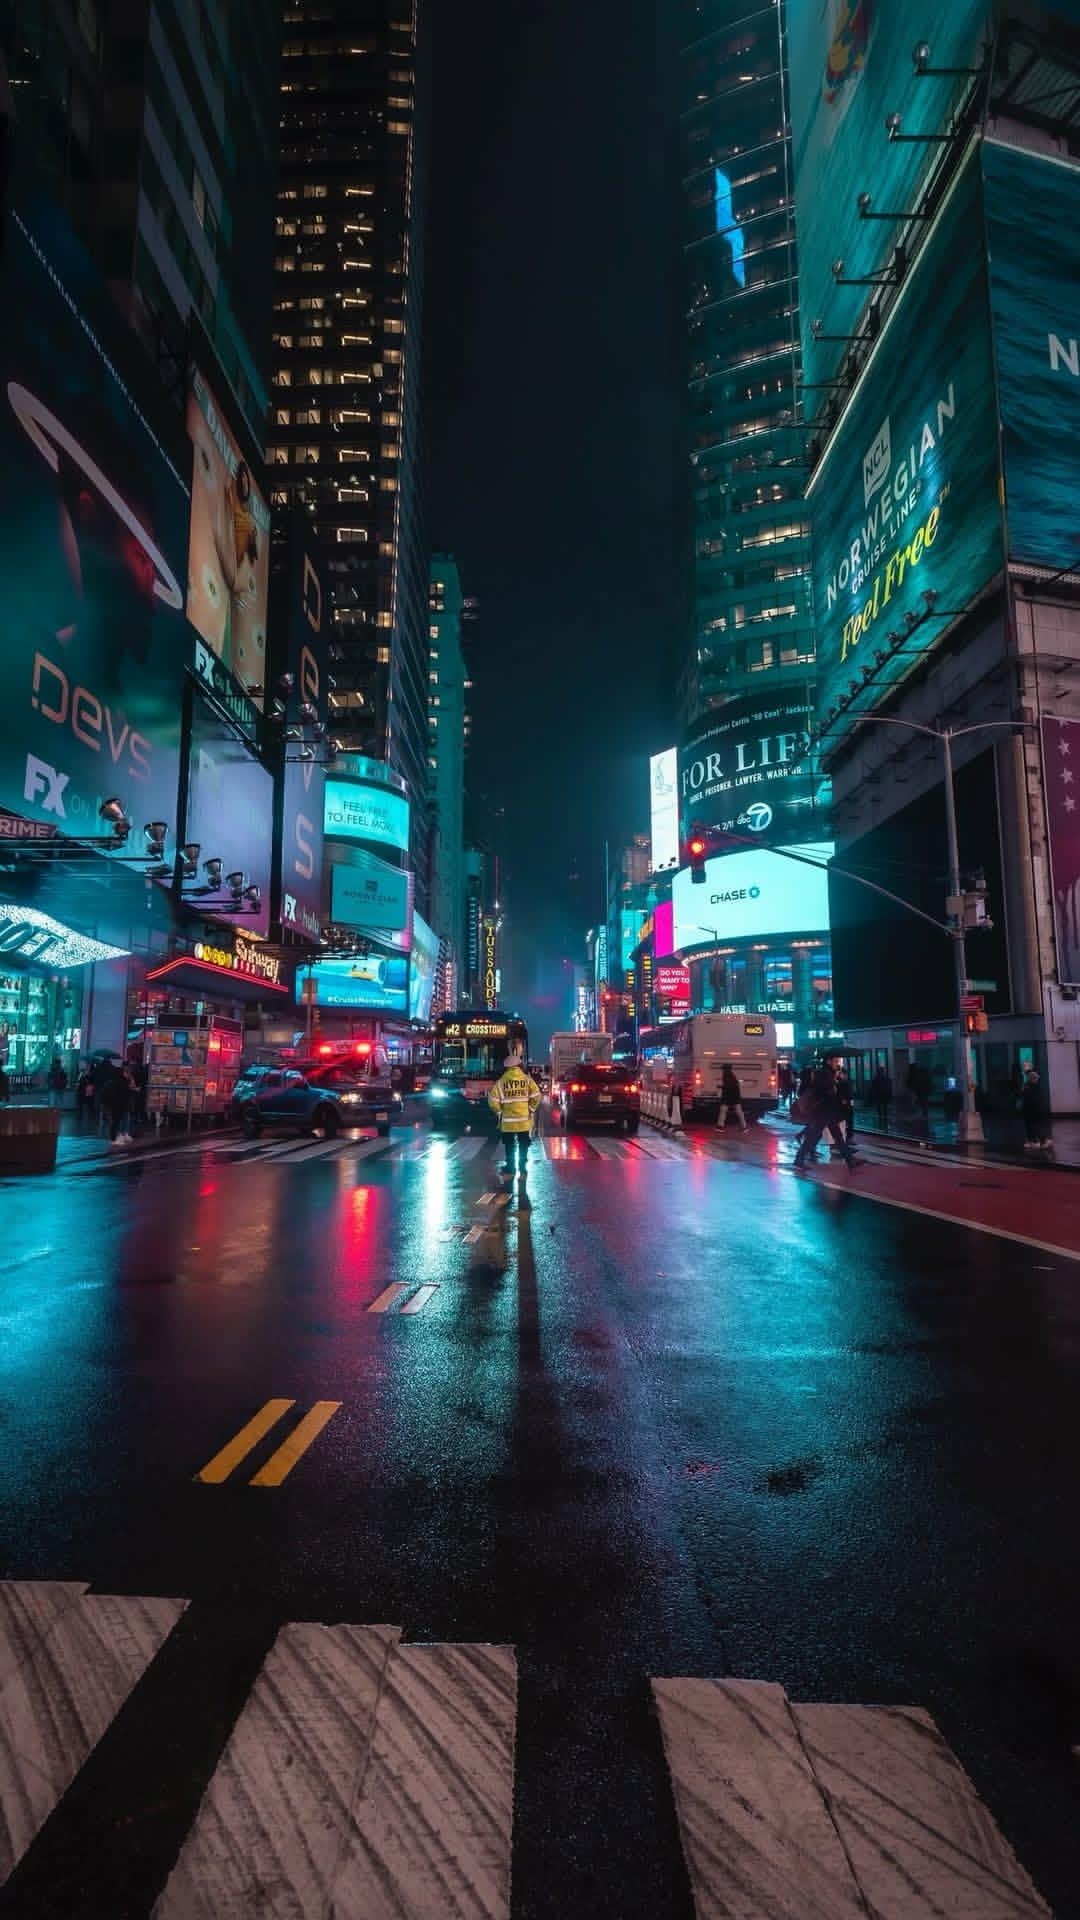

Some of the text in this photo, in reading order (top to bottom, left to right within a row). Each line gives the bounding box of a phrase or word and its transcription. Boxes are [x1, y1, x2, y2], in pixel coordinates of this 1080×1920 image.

[864, 436, 890, 477] NCL
[826, 382, 956, 610] NORWEGIAN
[850, 534, 888, 595] CRUISE
[840, 574, 882, 665] Feel
[194, 638, 216, 689] FX
[24, 752, 70, 819] FX
[682, 752, 724, 797] FOR
[327, 812, 343, 823] TO
[347, 814, 368, 826] FEEL
[737, 813, 752, 825] abc
[284, 893, 297, 923] FX
[710, 888, 747, 905] CHASE
[235, 938, 280, 985] Subway
[485, 927, 496, 1012] TUSSAUDS
[757, 1002, 796, 1013] CHASE
[465, 1024, 507, 1035] CROSSTOWN
[503, 1079, 526, 1090] NYPD
